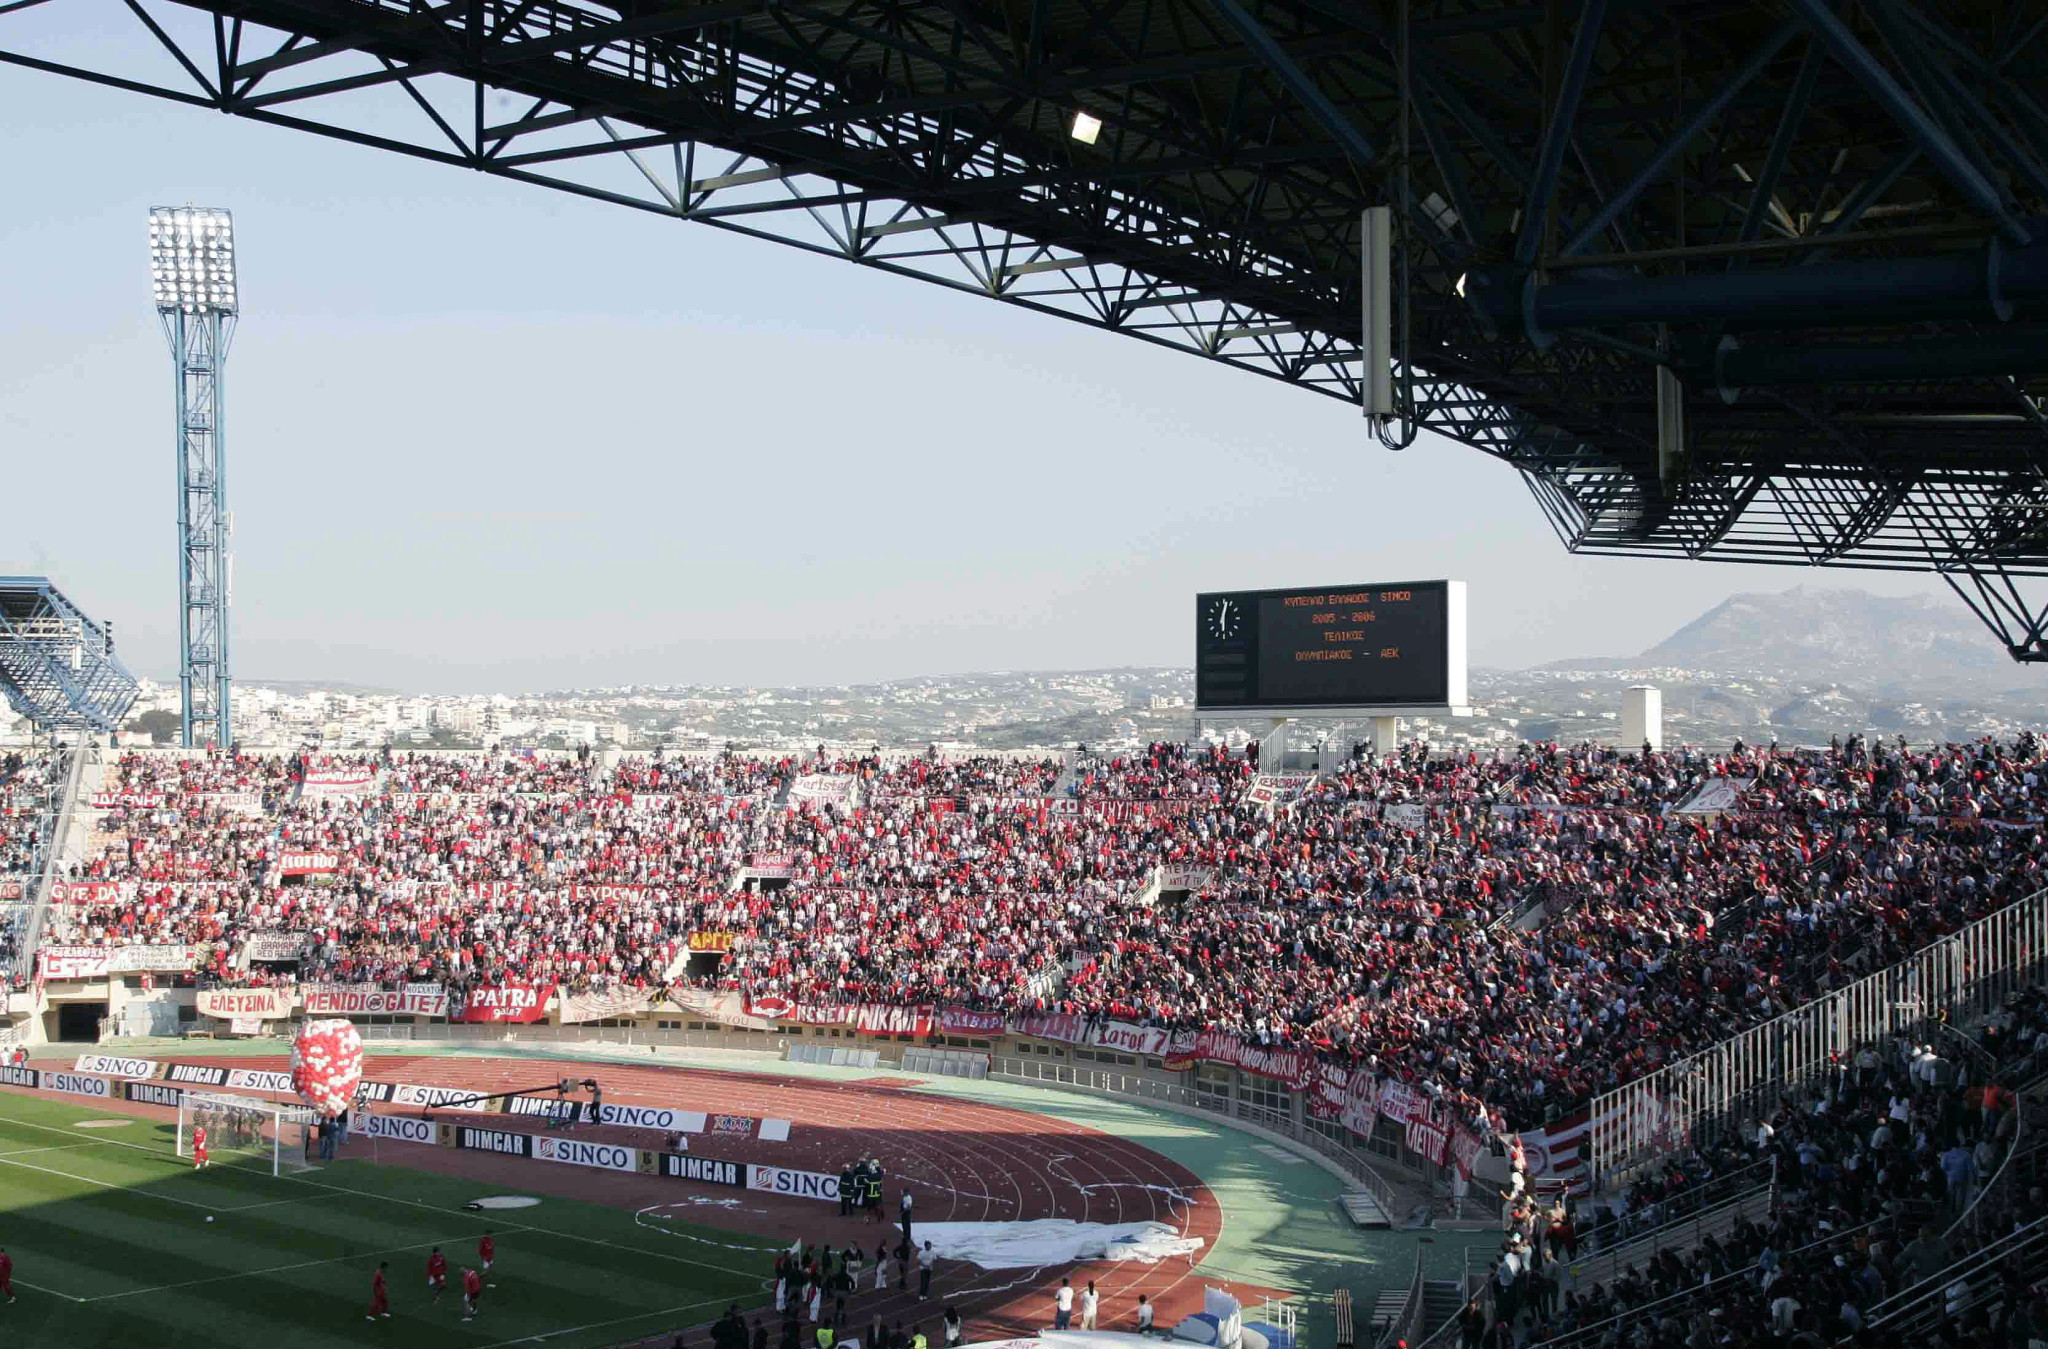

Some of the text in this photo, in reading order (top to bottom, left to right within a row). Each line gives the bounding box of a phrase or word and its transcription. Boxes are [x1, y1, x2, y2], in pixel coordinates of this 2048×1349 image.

[1312, 613, 1336, 624] 2005
[1352, 611, 1376, 622] 2006
[210, 995, 275, 1012] ΕΛΕΥΣΙΝΑ
[304, 993, 364, 1011] MENIDI
[472, 988, 538, 1008] PATRA
[725, 1016, 749, 1026] YOU
[96, 1058, 148, 1077] SINCO
[171, 1064, 223, 1085] DIMCAR
[57, 1074, 105, 1095] SINCO
[131, 1086, 178, 1106] DIMCAR
[414, 1088, 479, 1108] SINCO
[602, 1106, 673, 1128] SINCO
[368, 1117, 430, 1140] SINCO
[464, 1128, 524, 1155] DIMCAR
[556, 1141, 628, 1168] SINCO
[668, 1158, 737, 1185] DIMCAR
[776, 1170, 840, 1199] SINC
